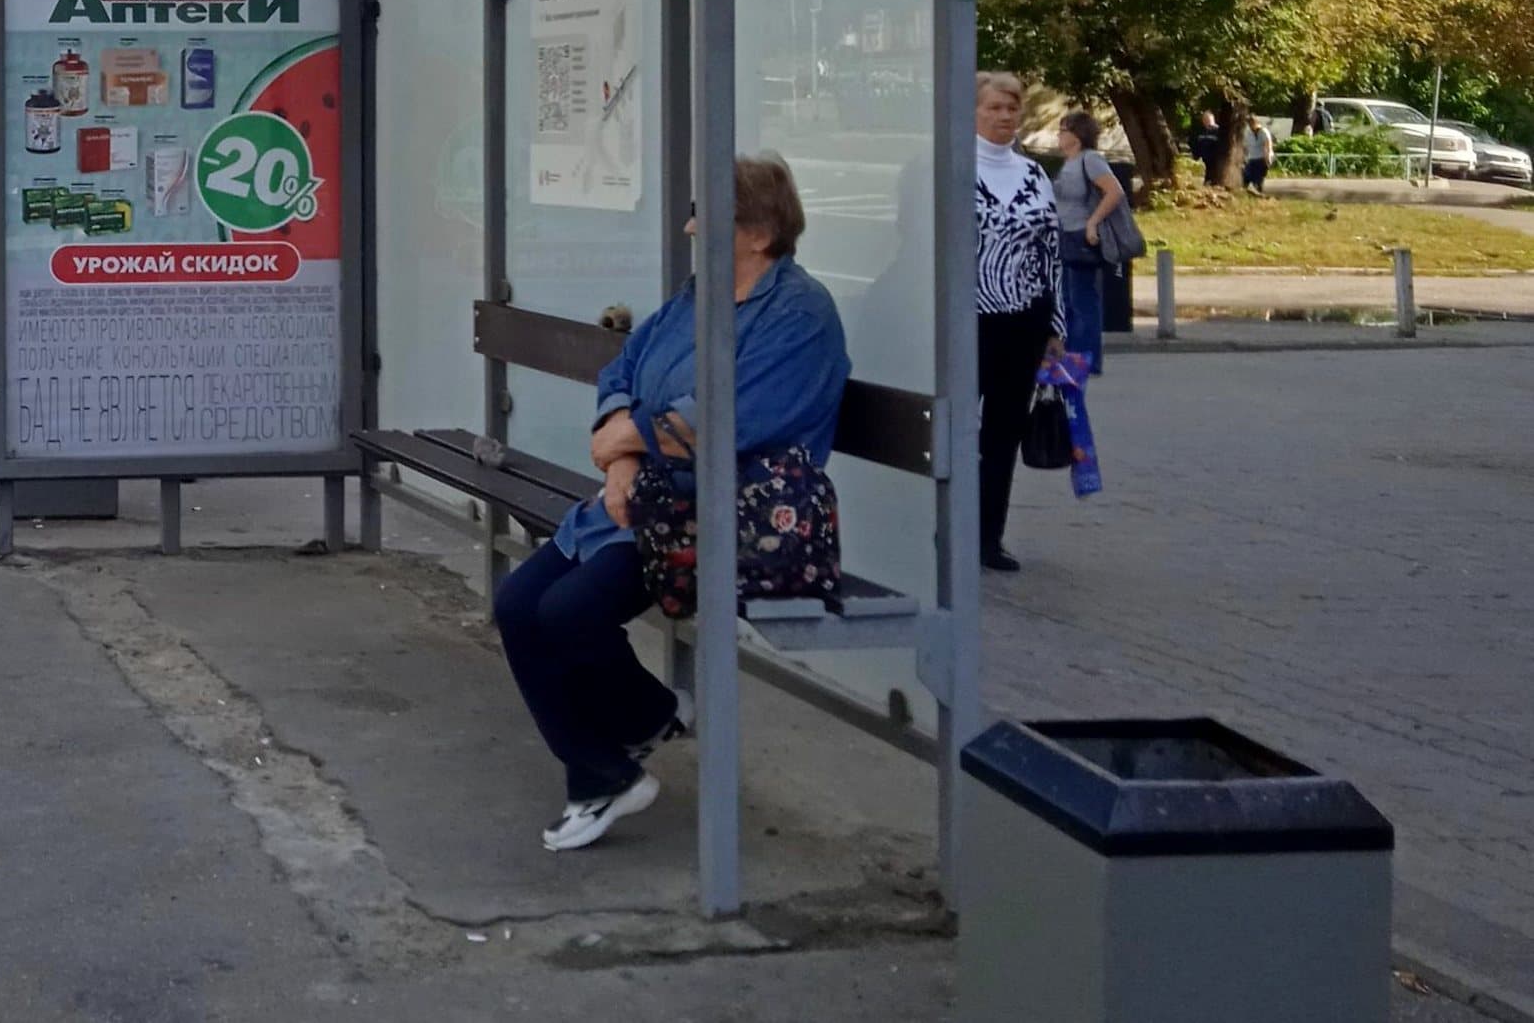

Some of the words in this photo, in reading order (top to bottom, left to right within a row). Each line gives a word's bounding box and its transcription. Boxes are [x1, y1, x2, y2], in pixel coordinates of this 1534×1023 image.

[72, 250, 176, 274] УРОЖАЙ
[181, 254, 279, 275] СКИДОК
[18, 318, 86, 343] ИМЕЮТСЯ
[241, 314, 335, 339] НЕОБХОДИМО
[18, 346, 103, 371] ПОЛУЧЕНИЕ
[113, 344, 226, 369] КОНСУЛЬТАЦИИ
[234, 342, 336, 368] СПЕЦИАЛИСТА
[69, 375, 93, 443] НЕ
[98, 374, 195, 443] ЯВЛЯЕТСЯ
[200, 405, 342, 442] СРЕДСТВОМ
